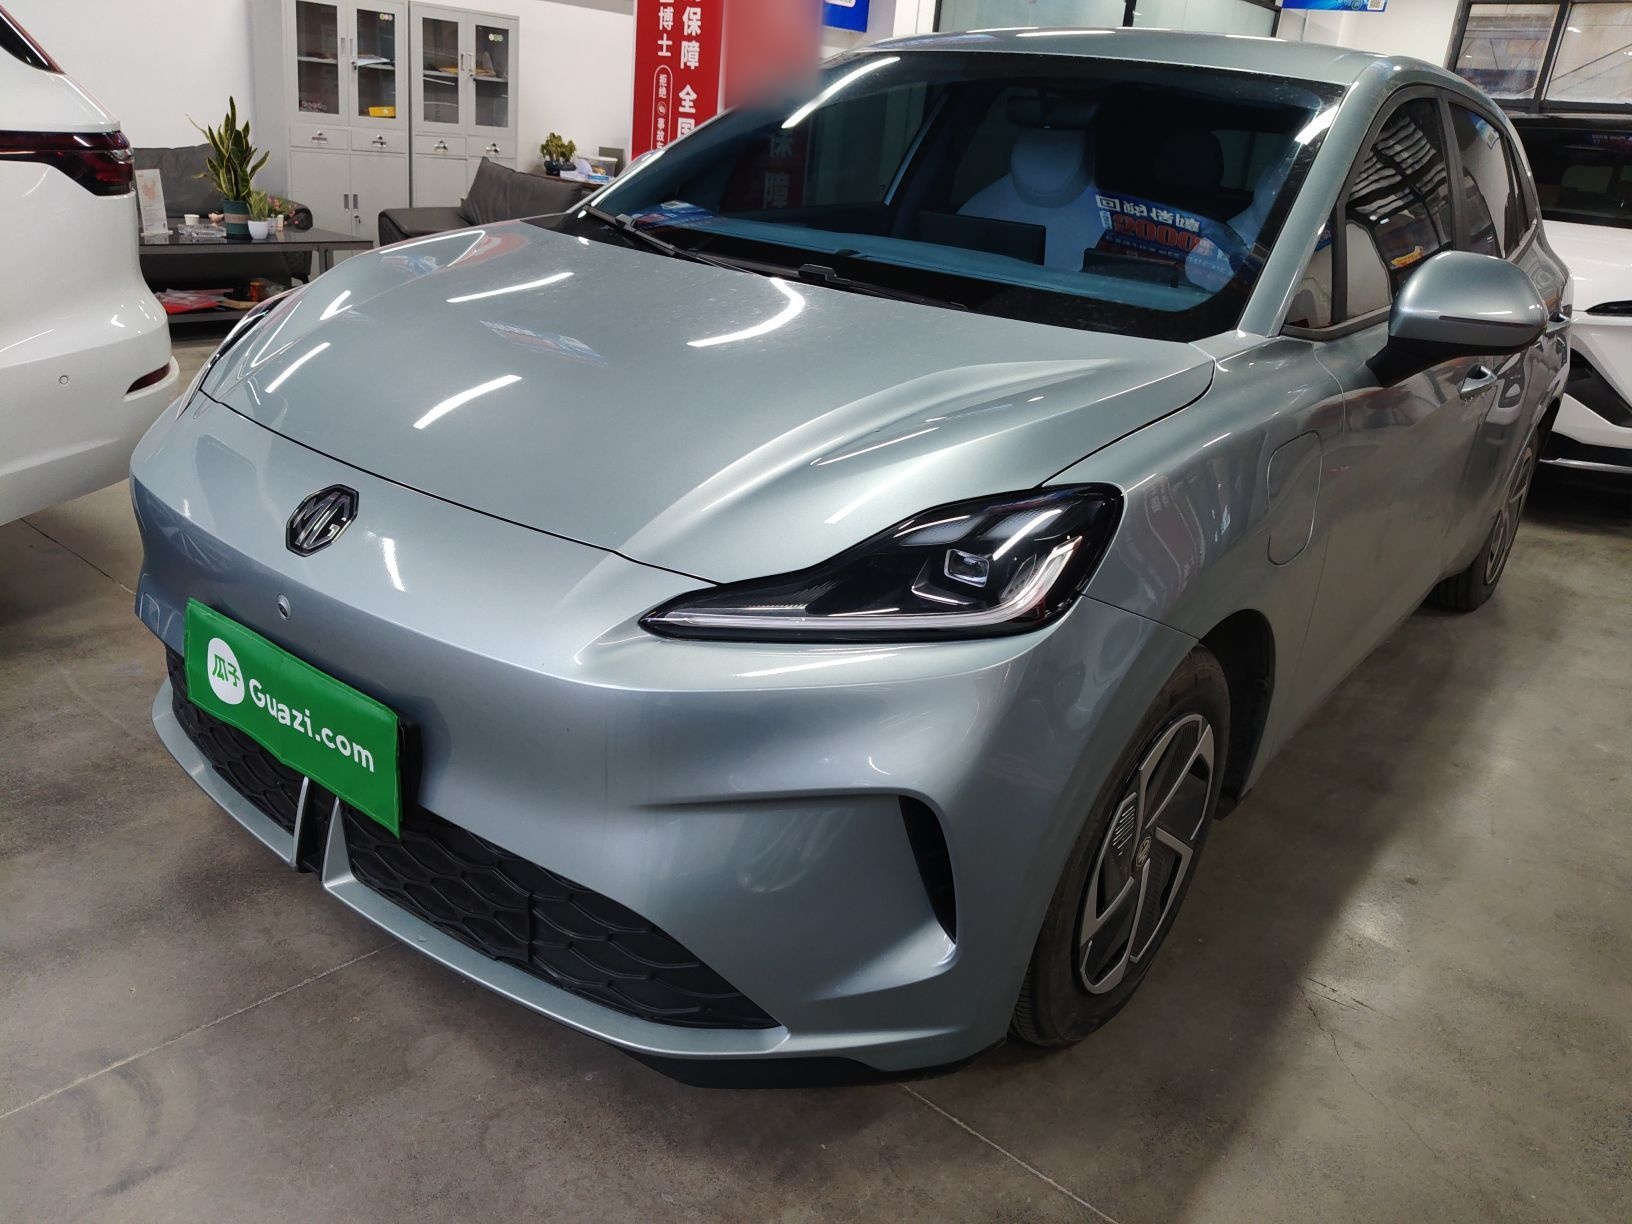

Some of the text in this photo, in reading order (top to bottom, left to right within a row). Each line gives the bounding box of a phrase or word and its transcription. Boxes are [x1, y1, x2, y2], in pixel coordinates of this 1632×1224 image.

[657, 0, 674, 56] 博士
[680, 0, 702, 70] 保障
[292, 489, 352, 551] MG
[211, 653, 241, 688] 瓜子
[248, 678, 376, 773] Guazi.com
